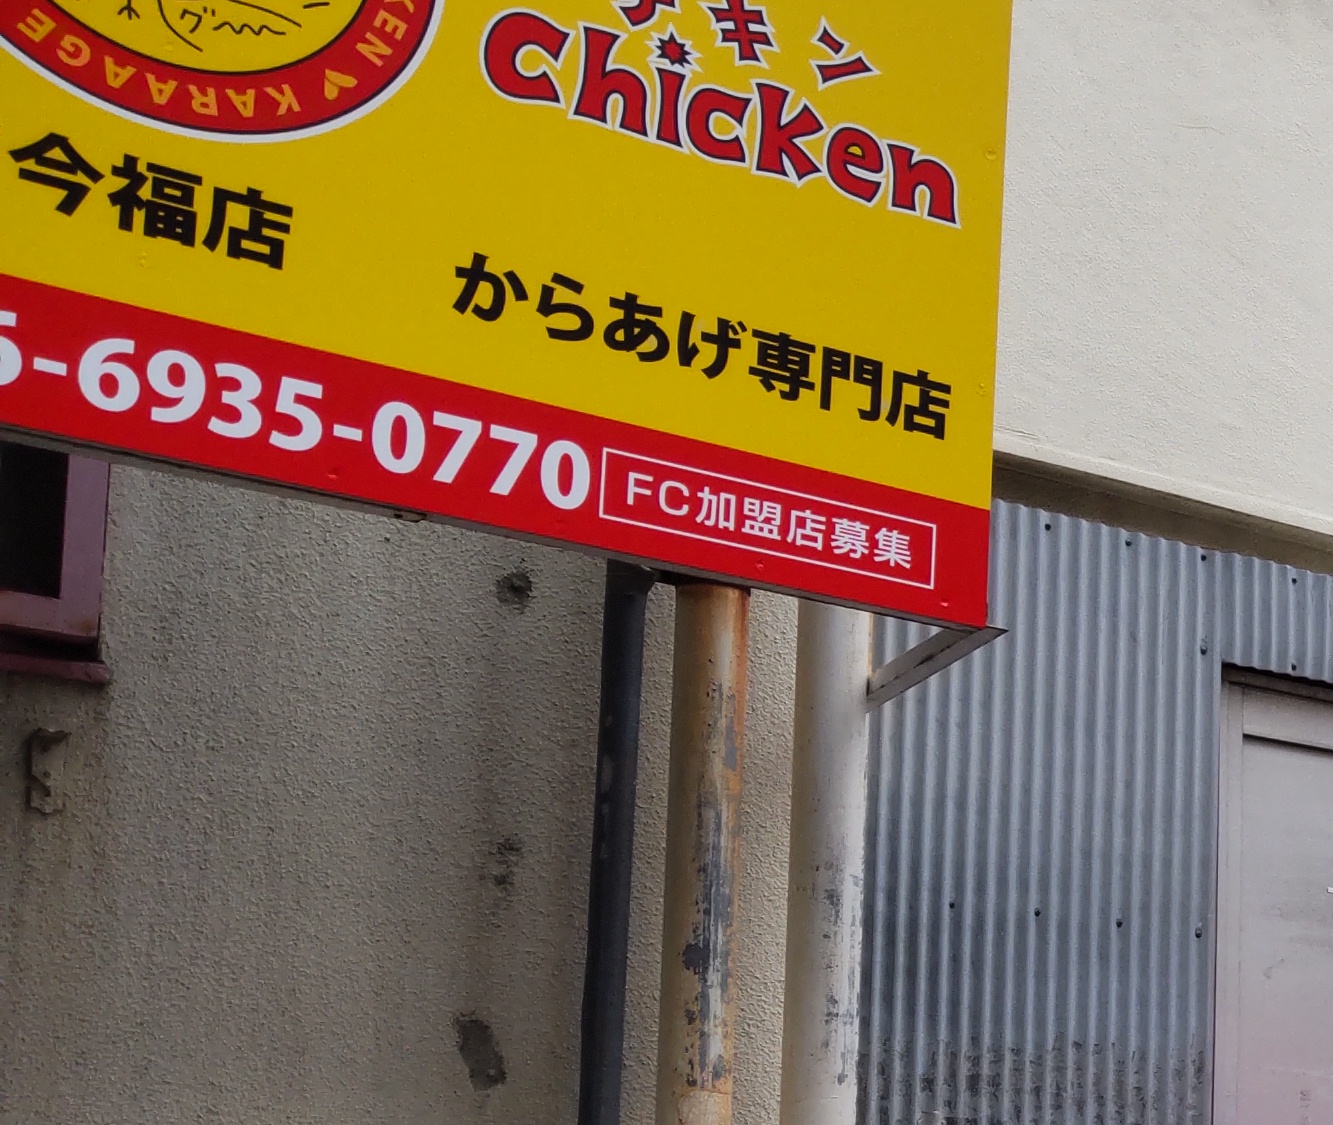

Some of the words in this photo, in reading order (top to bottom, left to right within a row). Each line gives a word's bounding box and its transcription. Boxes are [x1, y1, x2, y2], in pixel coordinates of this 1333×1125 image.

[16, 8, 301, 118] KARAAGE
[8, 131, 294, 271] 今福店
[452, 252, 953, 441] からあげ専門店
[627, 473, 913, 568] FC加盟店募集
